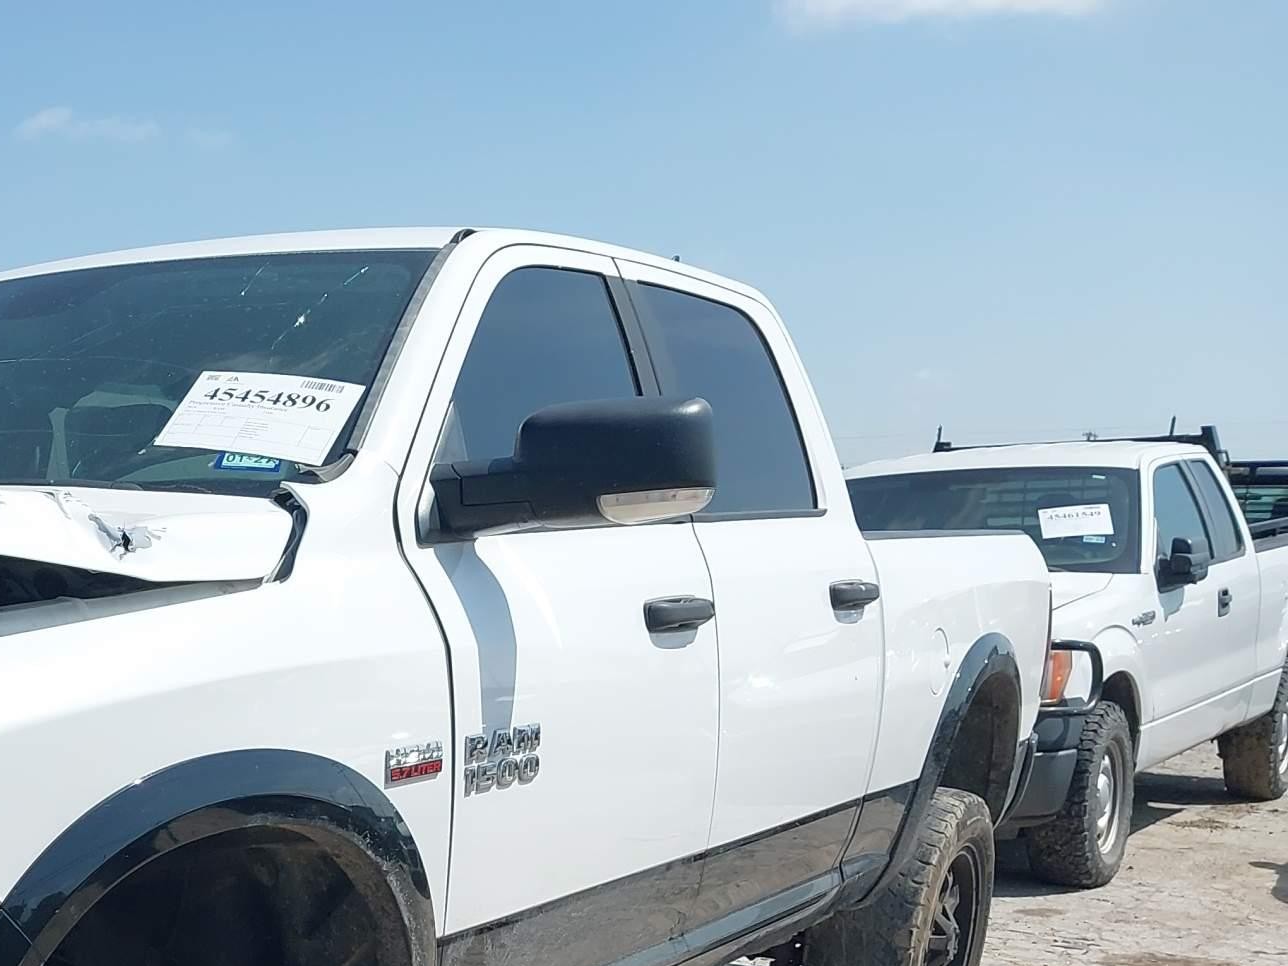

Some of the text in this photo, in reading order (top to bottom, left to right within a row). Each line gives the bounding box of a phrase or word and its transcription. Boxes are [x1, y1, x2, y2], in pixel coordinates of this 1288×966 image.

[204, 386, 335, 414] 45454896
[464, 723, 541, 766] RAM
[392, 761, 441, 780] 5.7 LITER
[464, 753, 541, 798] 1500
